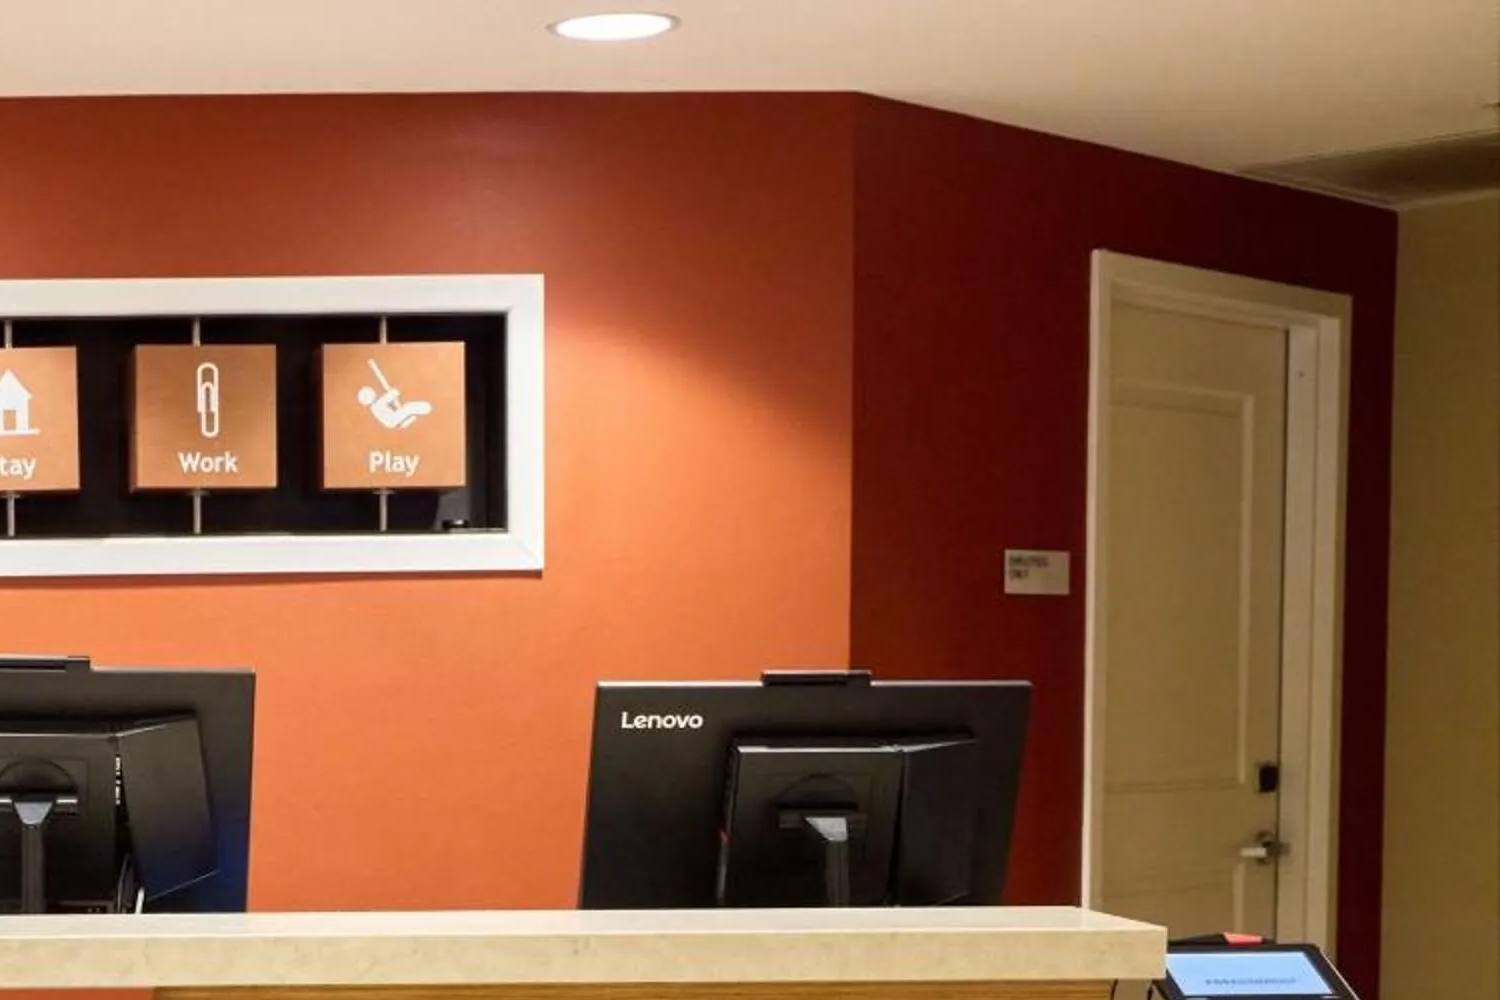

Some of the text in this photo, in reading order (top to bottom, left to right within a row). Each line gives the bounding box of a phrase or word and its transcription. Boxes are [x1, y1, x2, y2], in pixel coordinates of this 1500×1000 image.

[179, 452, 238, 473] Work
[369, 450, 420, 476] Play
[620, 711, 704, 730] Lenovo
